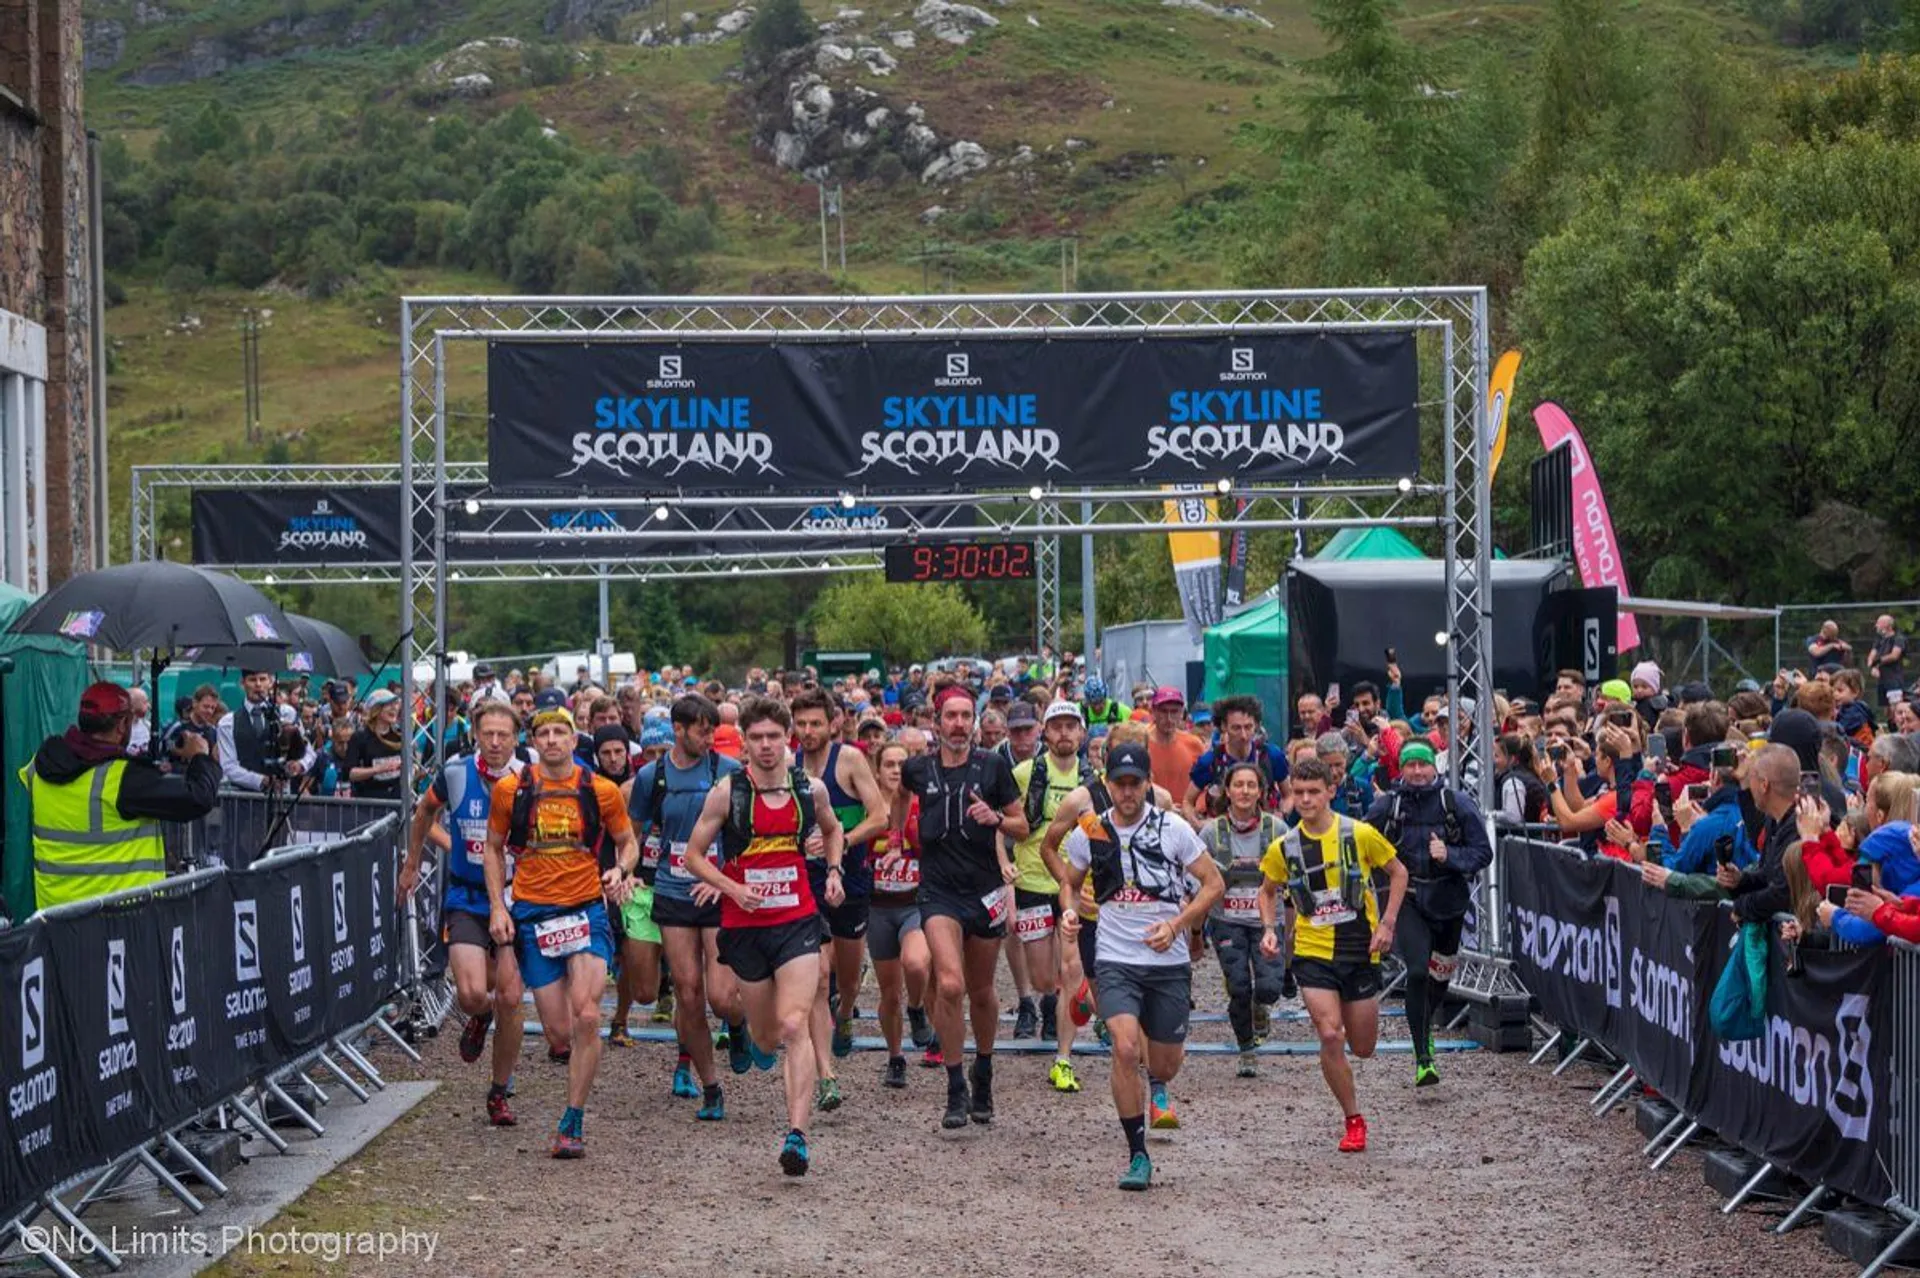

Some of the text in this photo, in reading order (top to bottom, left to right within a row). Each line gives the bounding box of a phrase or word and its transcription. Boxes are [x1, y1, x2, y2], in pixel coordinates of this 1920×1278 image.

[647, 379, 695, 388] salomon
[934, 377, 982, 386] salomon
[1219, 372, 1267, 380] salomon
[595, 397, 750, 429] SKYLINE
[883, 394, 1036, 428] SKYLINE
[1169, 388, 1321, 422] SKYLINE
[566, 432, 778, 469] SCOTLAND
[856, 429, 1066, 468] SCOTLAND
[1141, 423, 1350, 464] SCOTLAND
[280, 531, 367, 548] SCOTLAND
[762, 883, 791, 896] 784
[545, 926, 584, 947] 0956
[1630, 947, 1690, 1043] slomon
[9, 1066, 57, 1119] salomon
